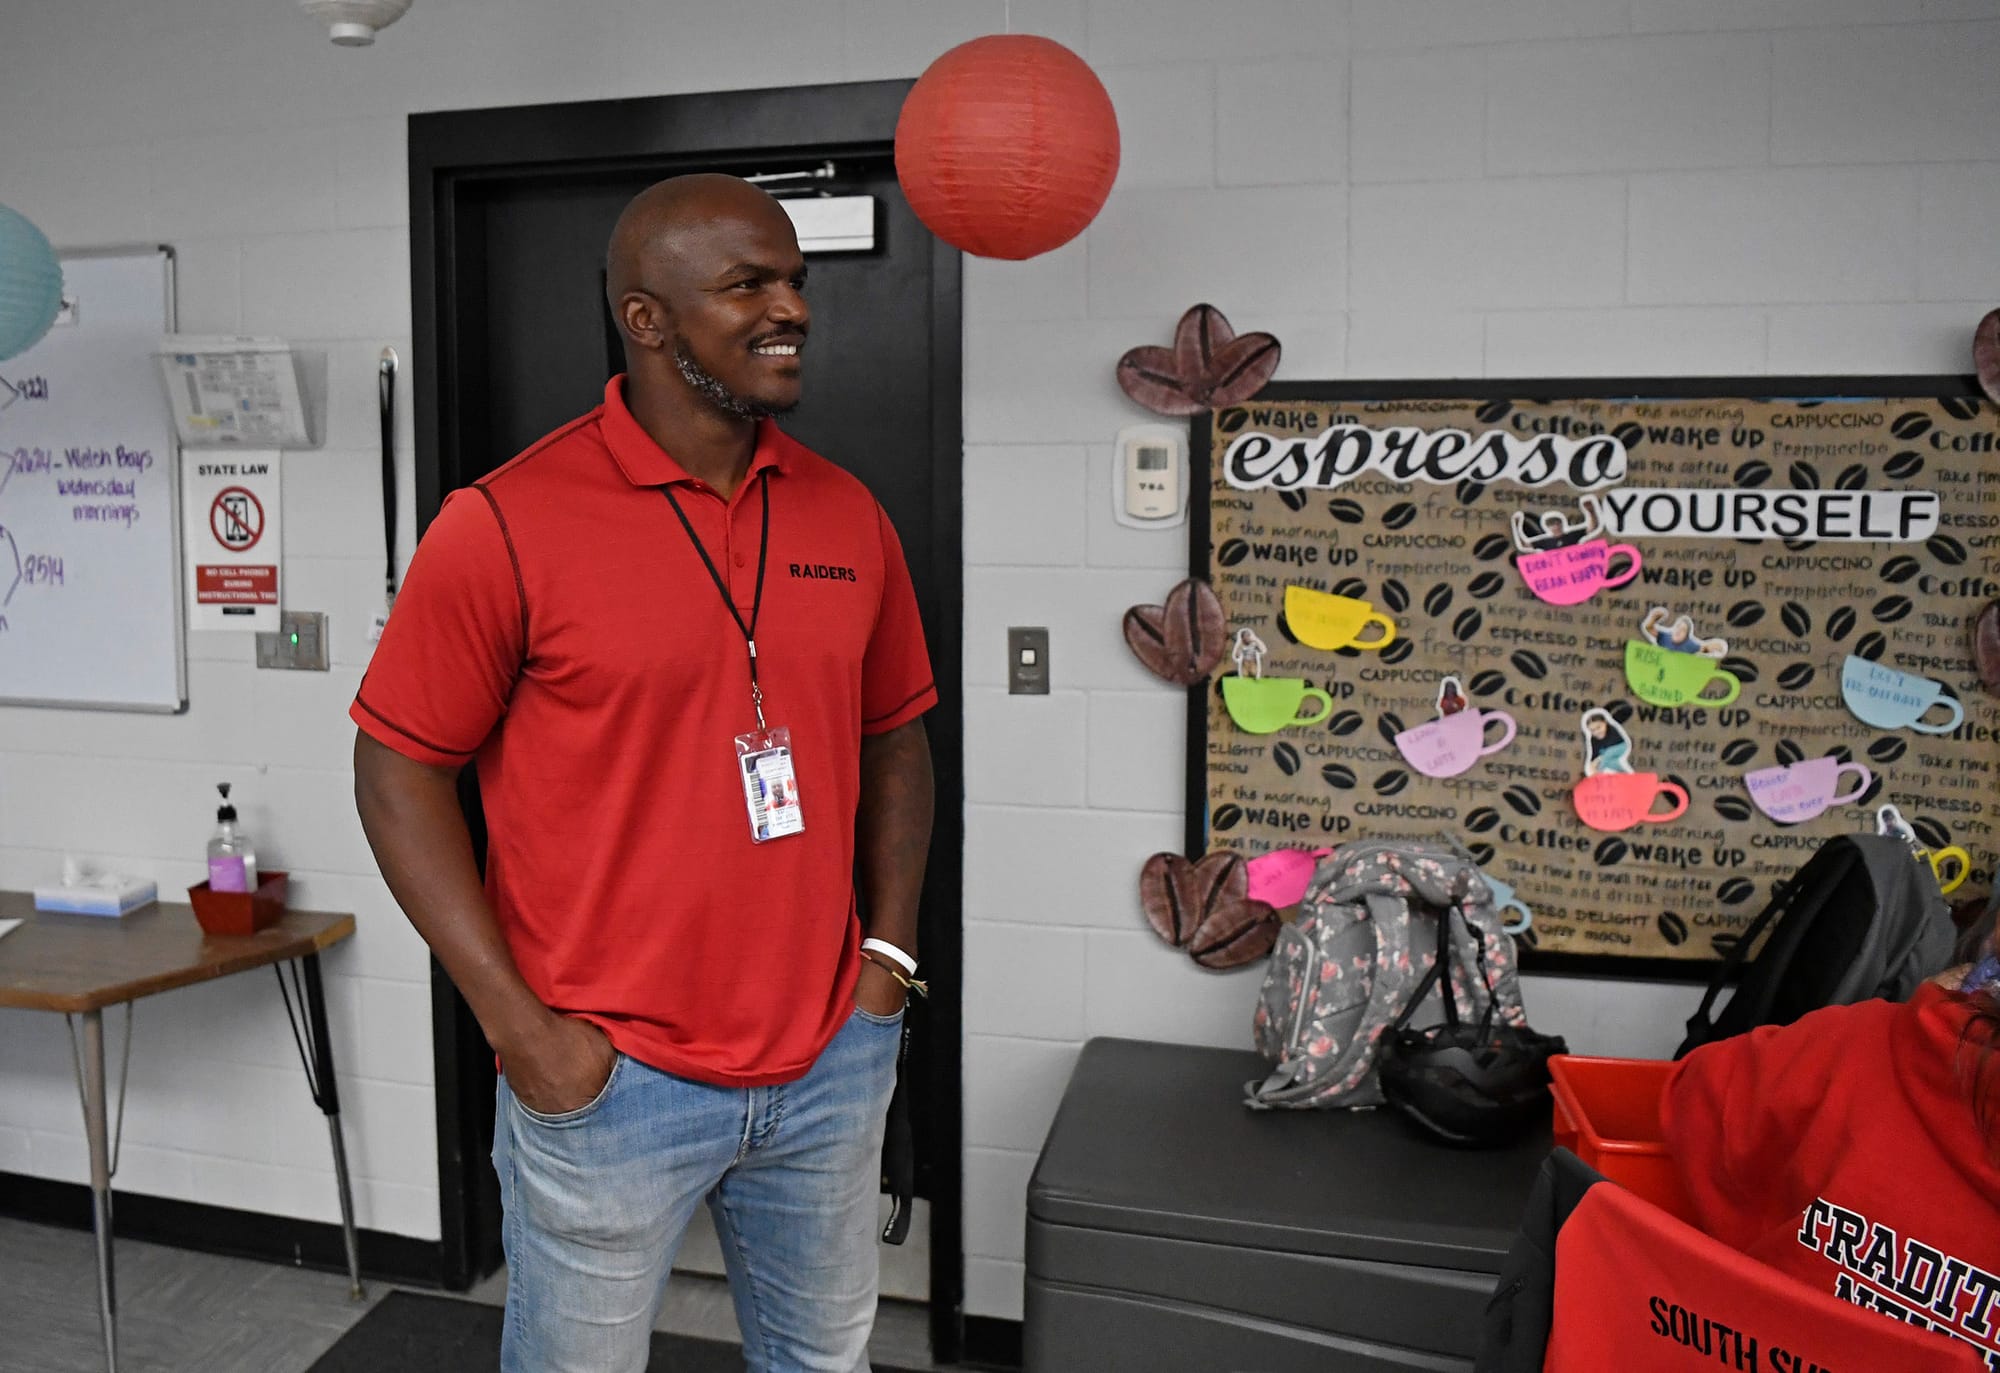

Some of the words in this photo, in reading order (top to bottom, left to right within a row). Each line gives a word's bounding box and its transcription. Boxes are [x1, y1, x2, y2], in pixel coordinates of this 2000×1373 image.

[1512, 412, 1605, 435] Coffee
[1771, 413, 1884, 428] CAPPUCCINO
[199, 464, 238, 476] STATE
[241, 464, 268, 475] LAW
[1606, 493, 1936, 540] YOURSELF
[1363, 534, 1466, 548] CAPPUCCINO
[1762, 555, 1873, 571] CAPPUCCINO
[789, 563, 857, 582] RAIDERS
[1354, 803, 1457, 819] CAPPUCCINO
[1499, 823, 1591, 852] Coffee
[1650, 1296, 1758, 1373] SOUTH
